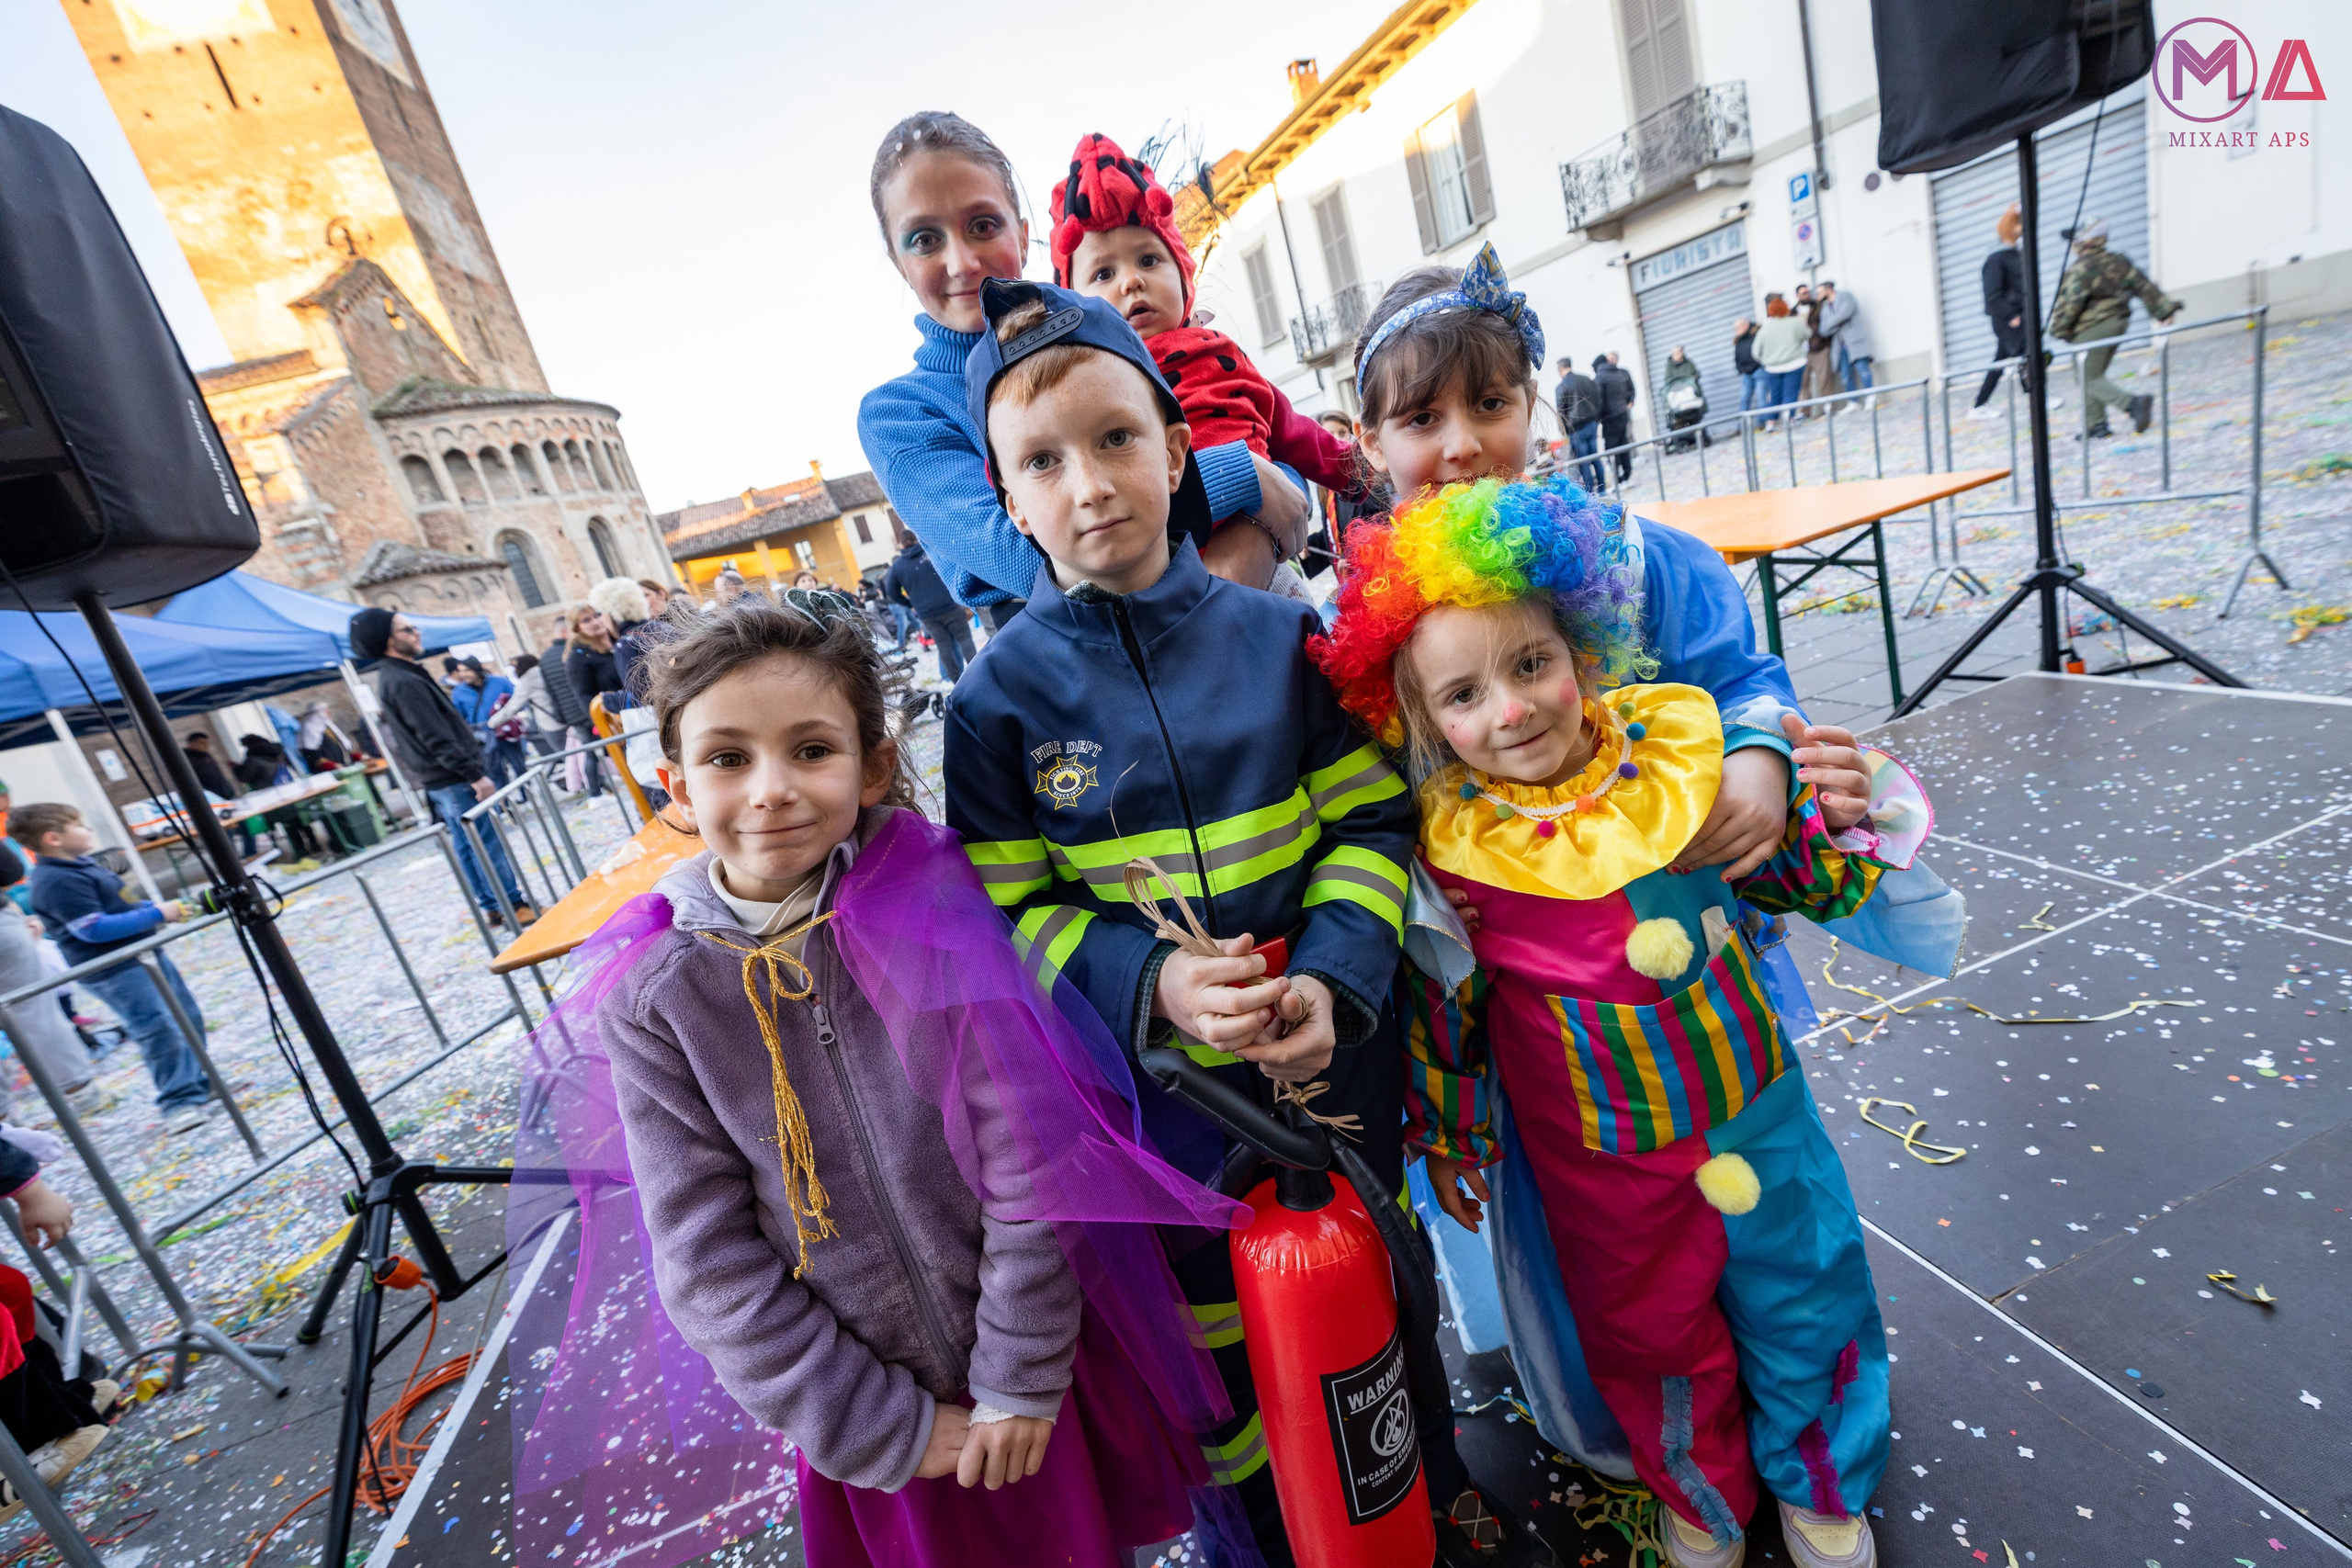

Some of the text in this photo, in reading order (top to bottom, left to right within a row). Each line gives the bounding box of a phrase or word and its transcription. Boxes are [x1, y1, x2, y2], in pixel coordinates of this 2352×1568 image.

[1031, 740, 1102, 763] FIRE DEPT
[1048, 766, 1086, 781] FIGHTING FIRE
[1357, 1476, 1368, 1486] IN
[1368, 1464, 1389, 1482] CASE
[1389, 1455, 1399, 1469] OF
[1371, 1469, 1394, 1488] CONTENT
